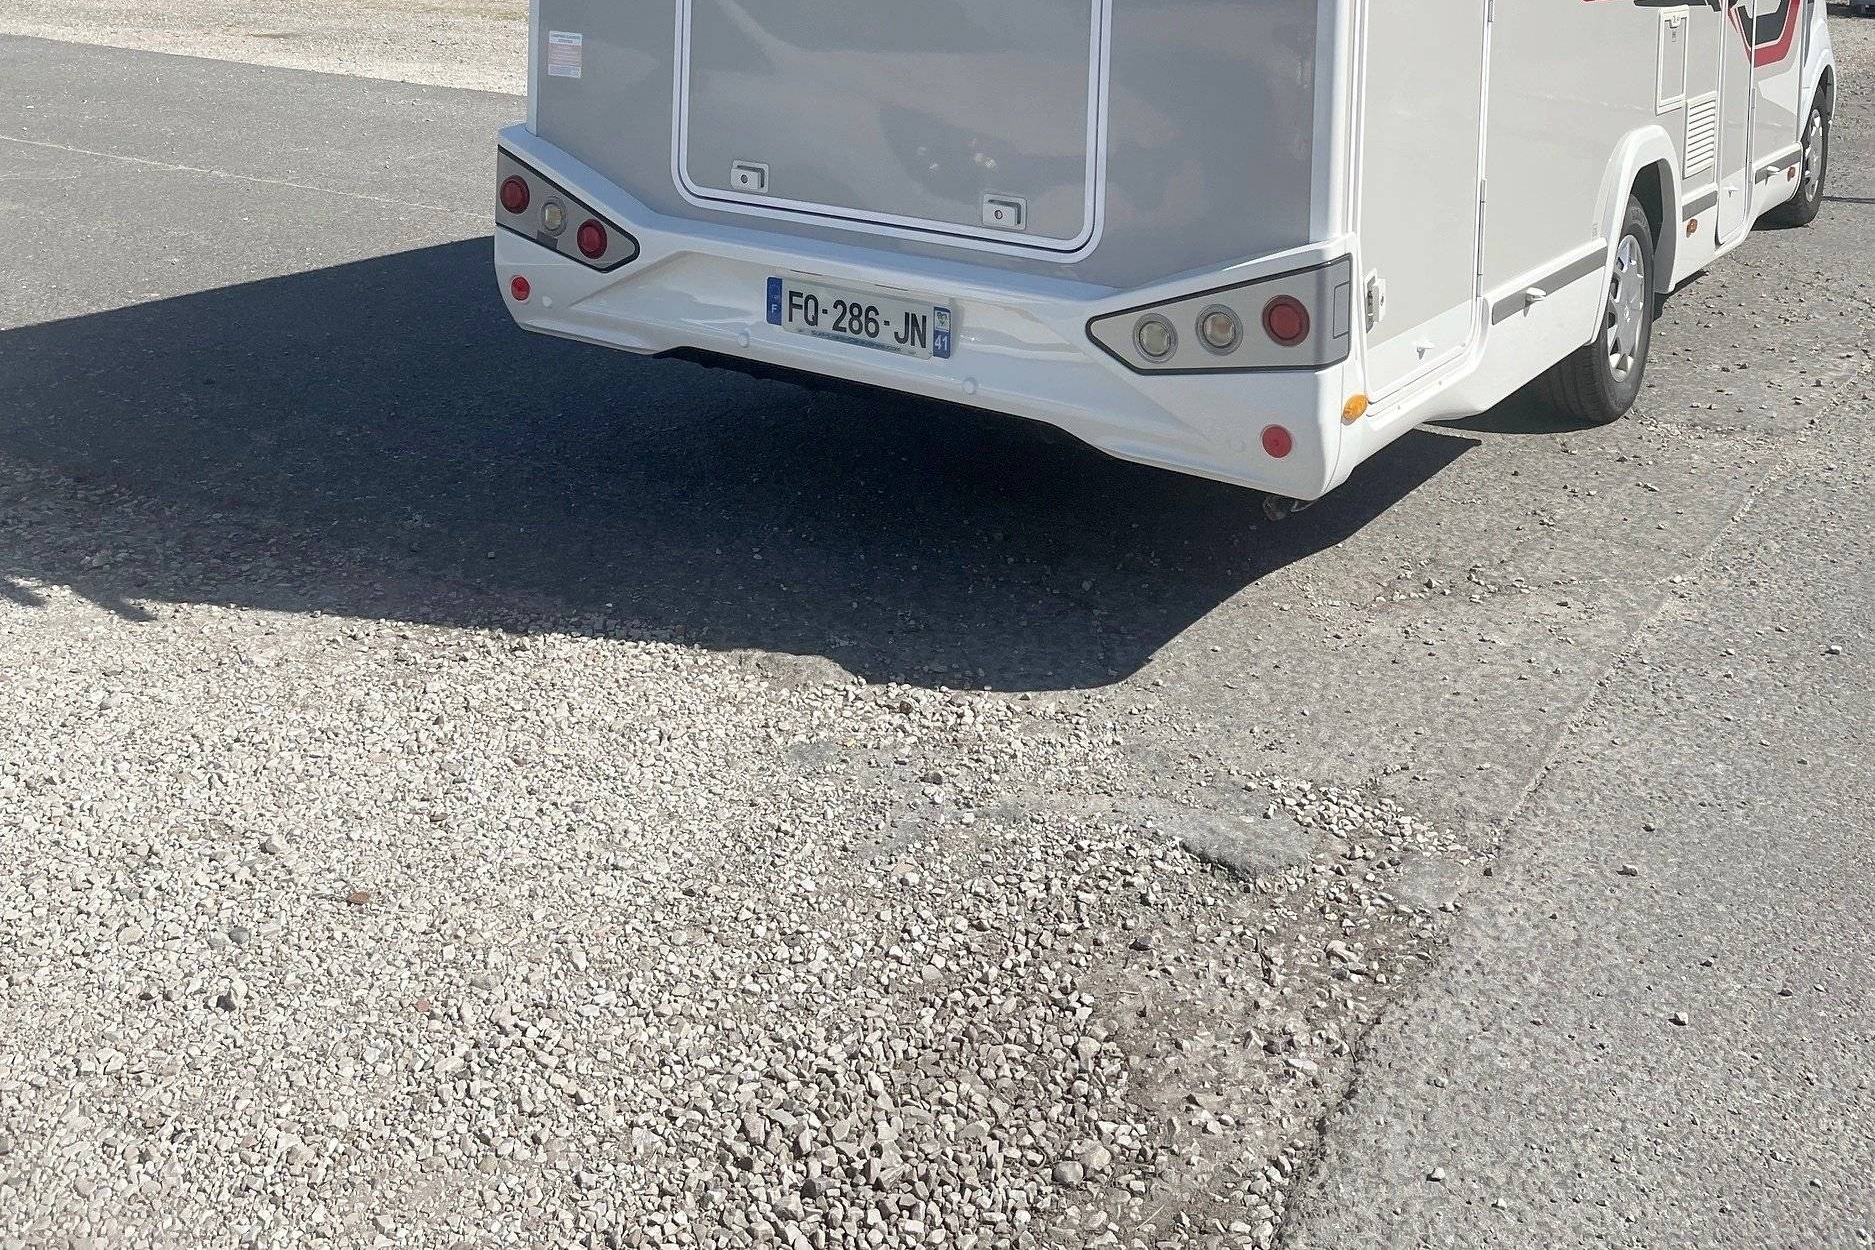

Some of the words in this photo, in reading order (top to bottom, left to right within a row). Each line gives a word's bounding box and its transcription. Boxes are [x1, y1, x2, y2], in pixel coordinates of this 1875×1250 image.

[771, 303, 778, 314] F
[788, 290, 928, 349] FQ-286-JN
[934, 335, 949, 351] 41
